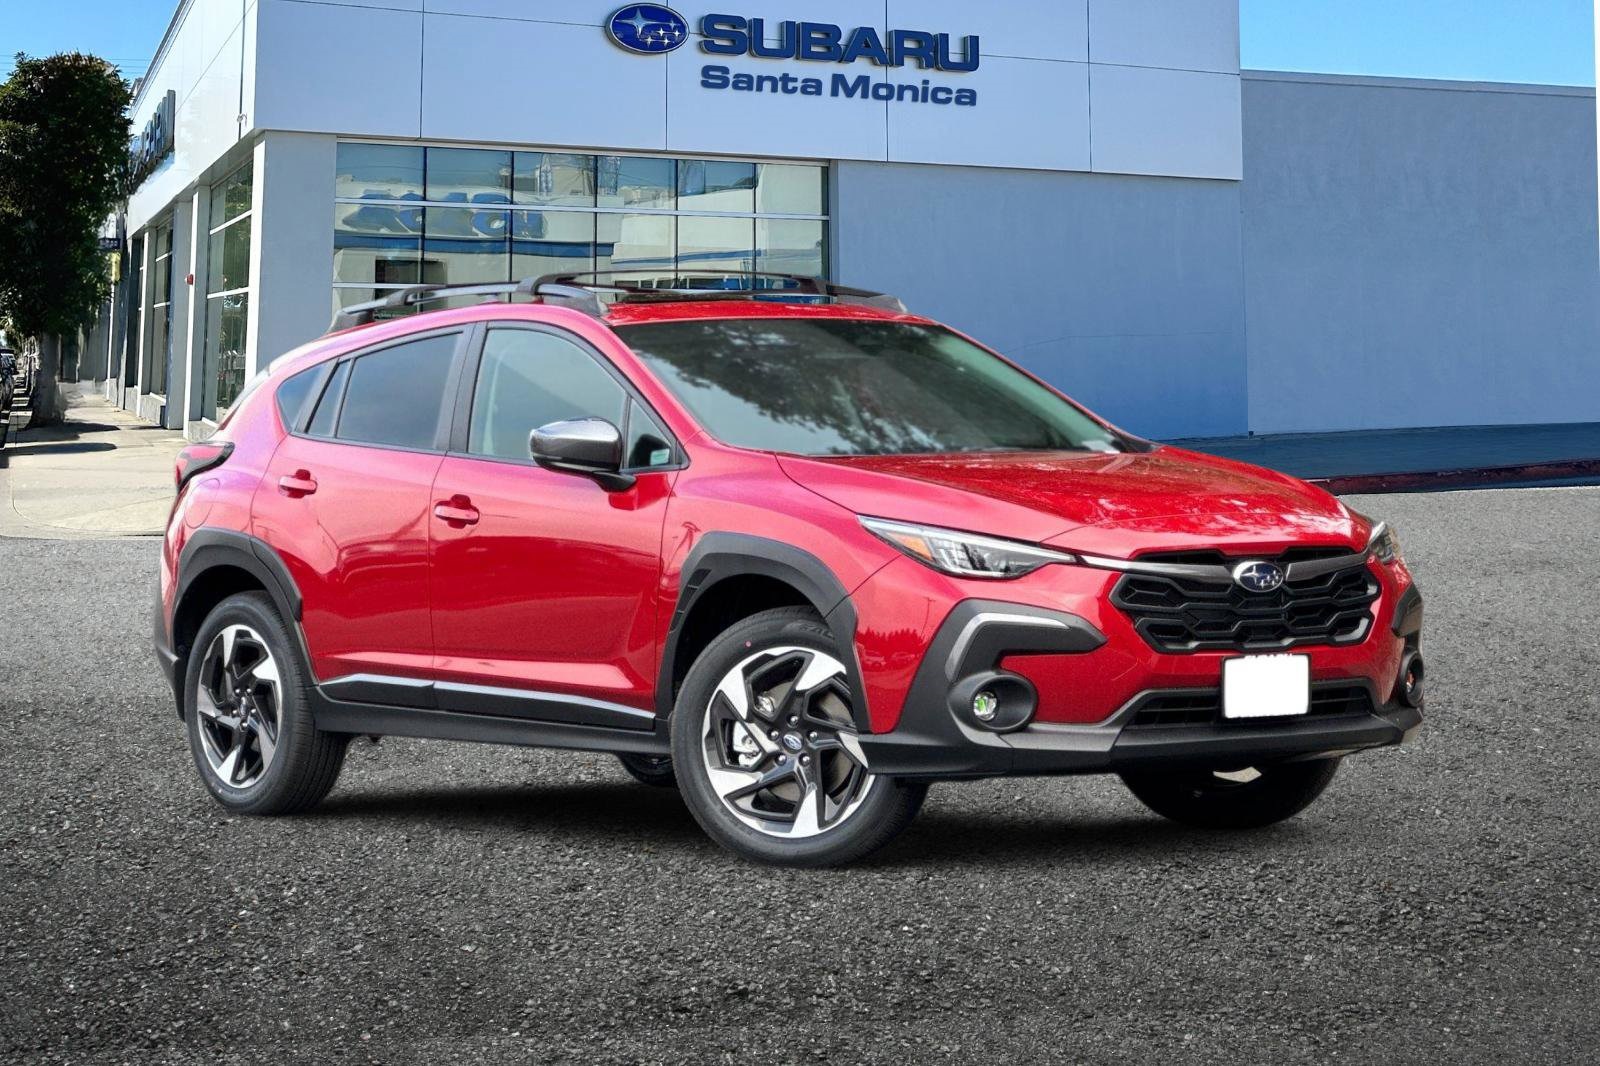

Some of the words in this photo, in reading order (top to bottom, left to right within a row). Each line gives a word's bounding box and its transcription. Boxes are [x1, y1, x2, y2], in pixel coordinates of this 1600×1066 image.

[700, 13, 980, 72] SUBARU
[700, 64, 823, 96] Santa
[831, 73, 977, 106] Monica
